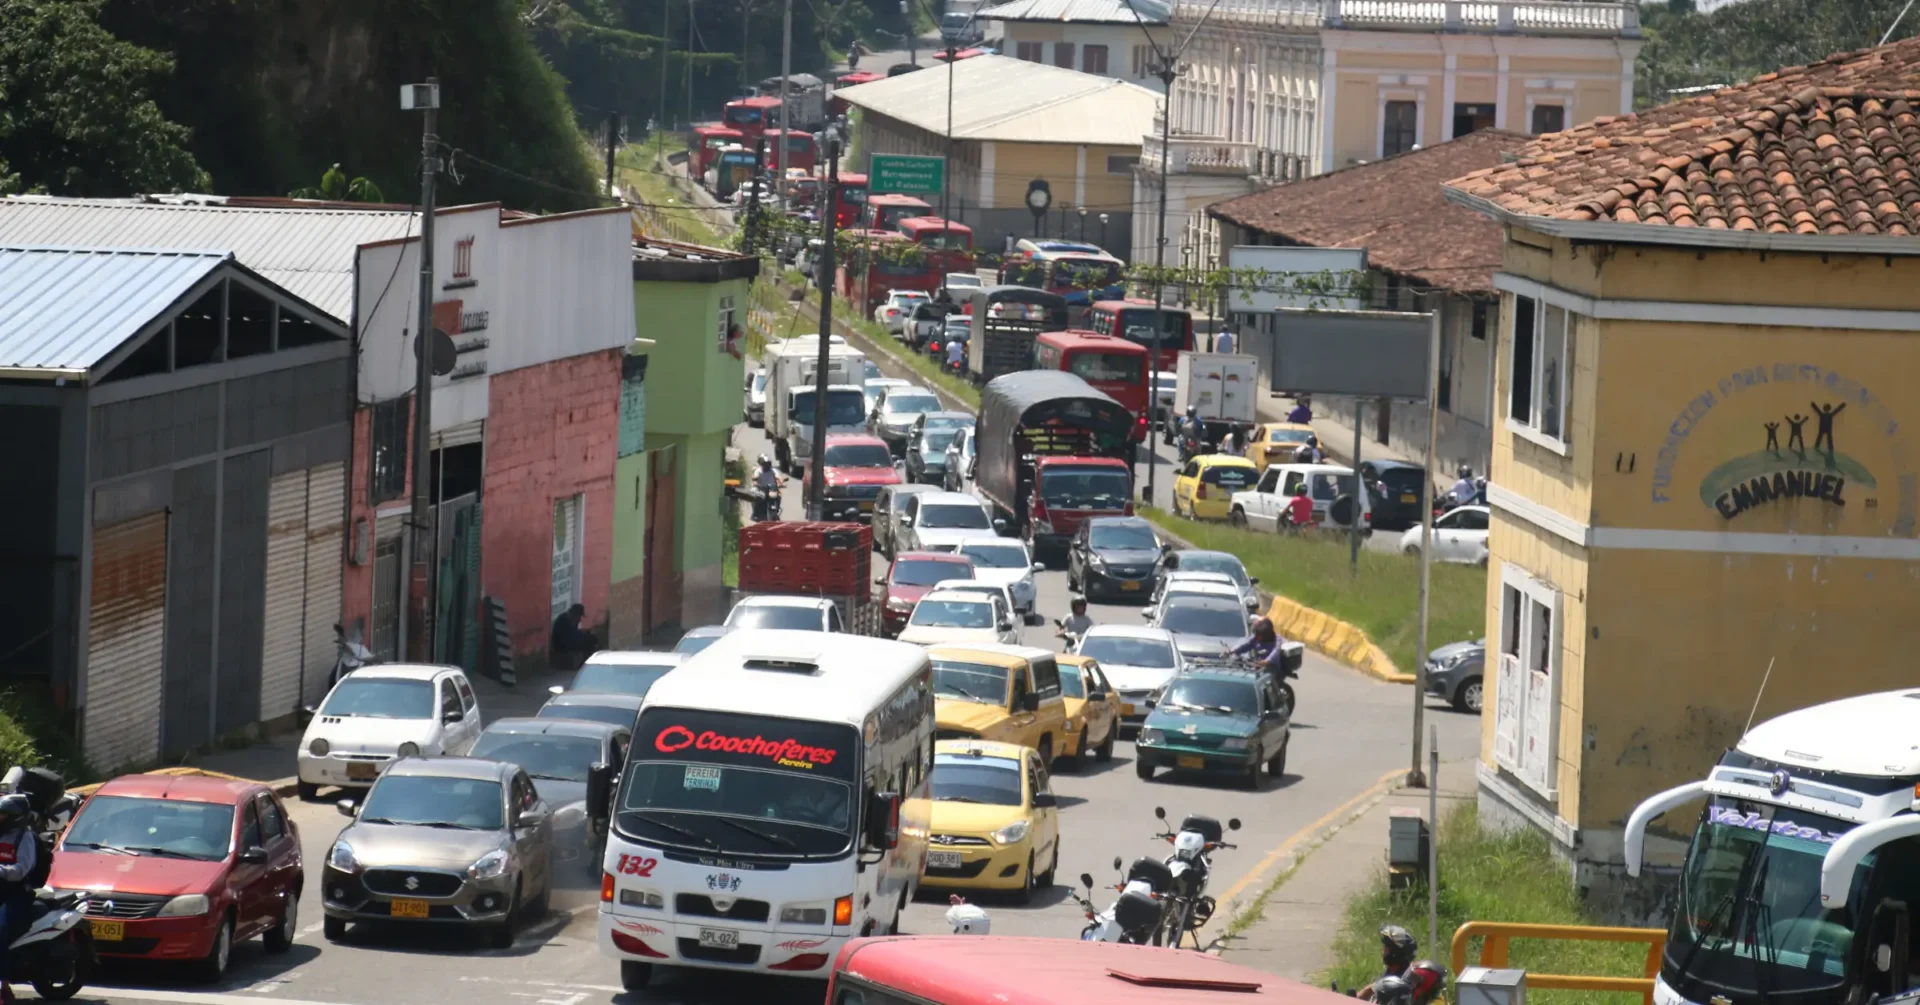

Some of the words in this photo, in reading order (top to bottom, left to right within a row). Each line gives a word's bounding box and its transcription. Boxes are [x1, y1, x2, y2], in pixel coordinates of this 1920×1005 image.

[1714, 470, 1847, 520] EMMANUEL
[695, 731, 836, 764] Coochoferes
[778, 757, 813, 769] Pereira
[687, 767, 720, 779] PEREIRA
[684, 777, 718, 789] TERMINAL
[616, 853, 658, 878] 132
